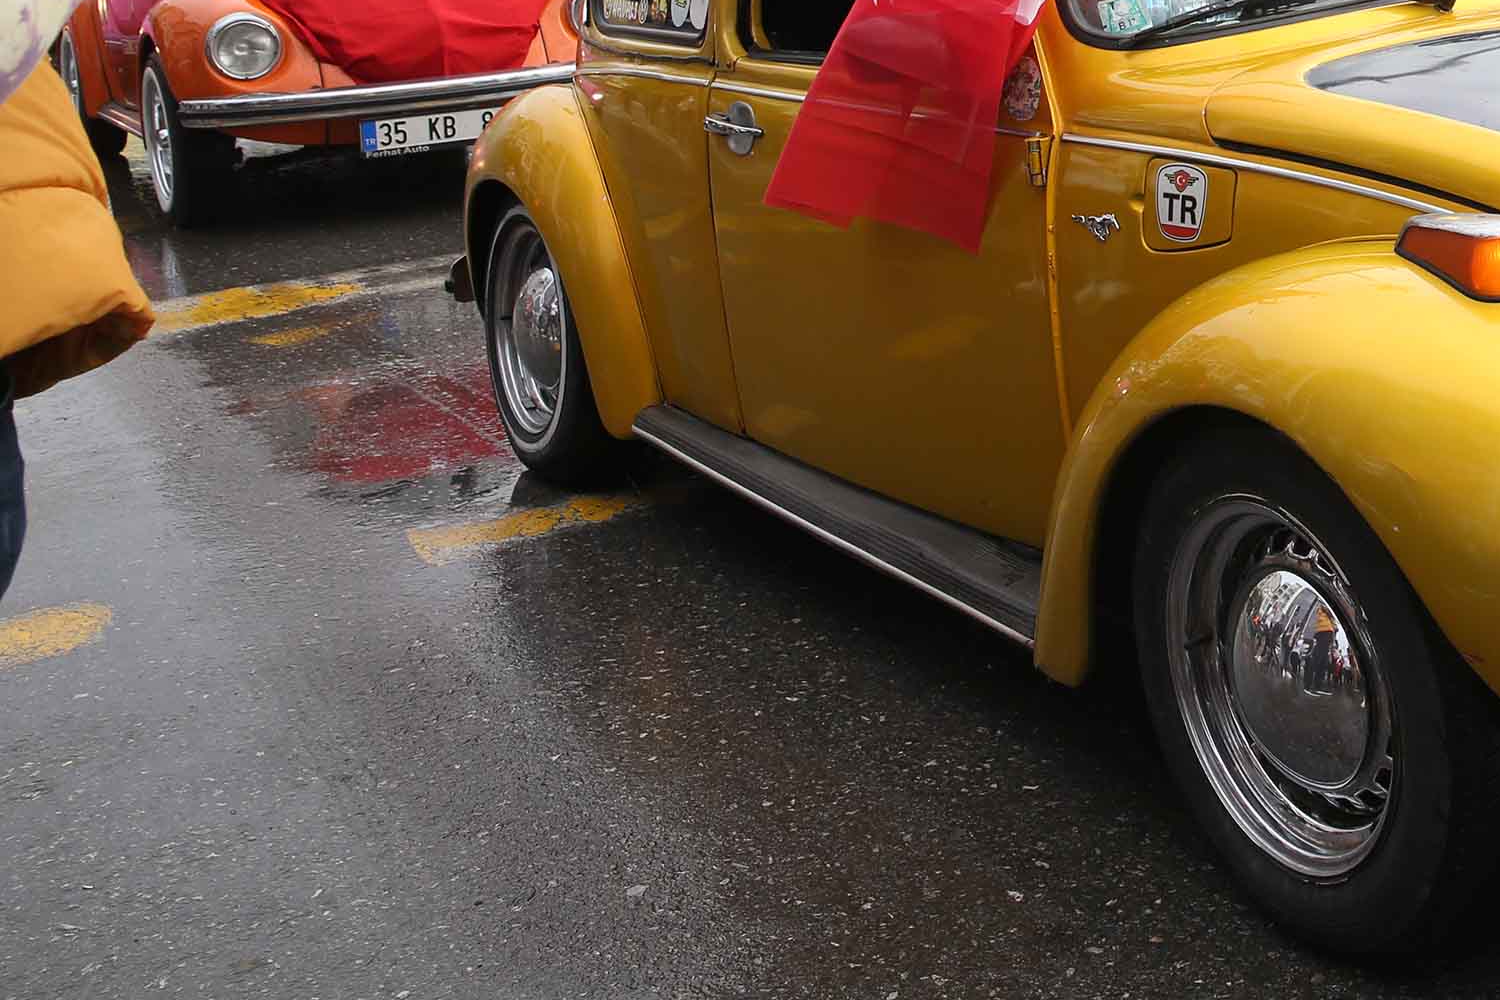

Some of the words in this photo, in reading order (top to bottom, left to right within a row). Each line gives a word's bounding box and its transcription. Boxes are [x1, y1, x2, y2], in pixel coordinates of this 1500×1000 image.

[365, 137, 377, 146] TR
[379, 120, 408, 146] 35
[428, 115, 457, 141] KB
[366, 147, 402, 159] Ferhat
[402, 144, 431, 154] Auto
[1162, 192, 1198, 226] TR
